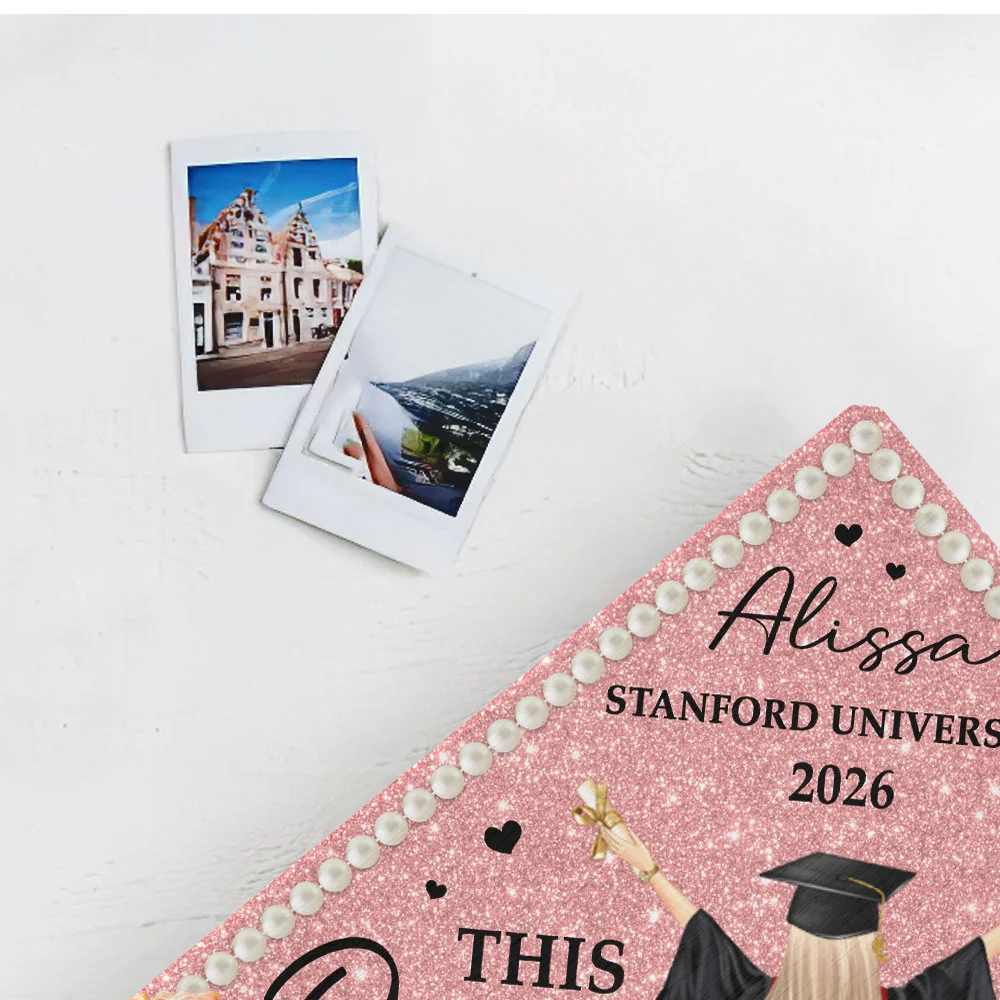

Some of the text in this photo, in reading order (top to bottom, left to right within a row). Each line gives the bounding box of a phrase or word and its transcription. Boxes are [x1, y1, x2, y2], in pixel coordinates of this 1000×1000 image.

[605, 684, 819, 732] STANFORD
[788, 761, 895, 810] 2026
[457, 927, 625, 995] THIS
